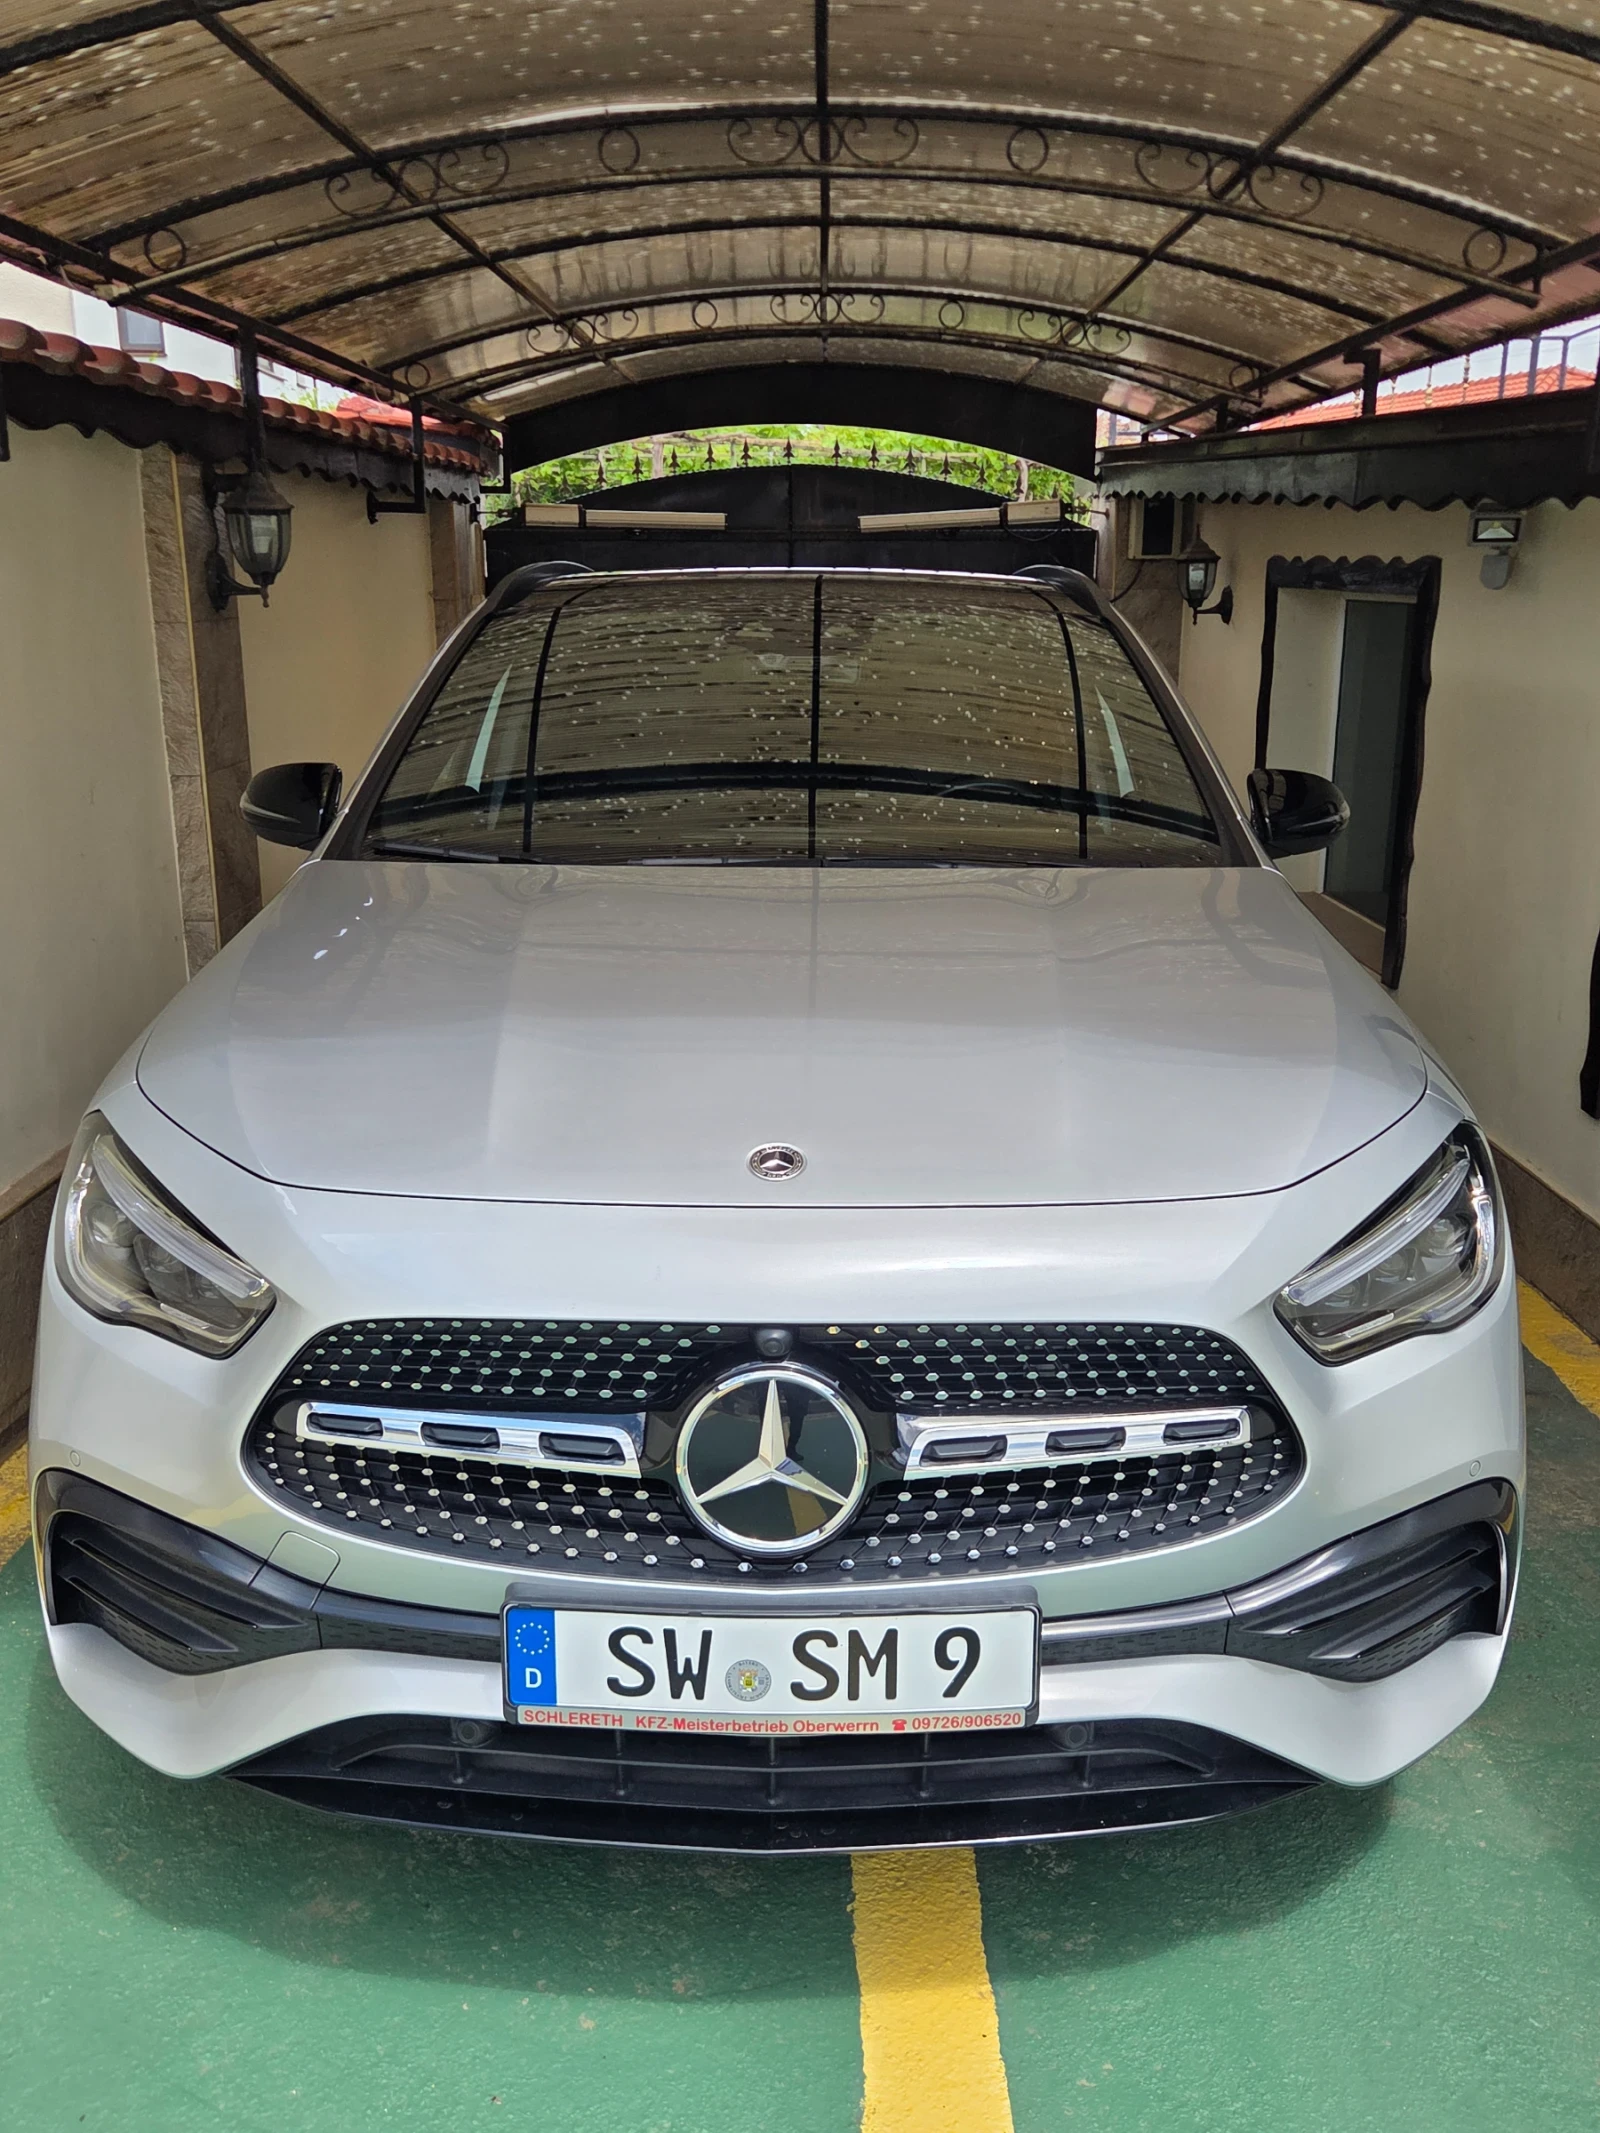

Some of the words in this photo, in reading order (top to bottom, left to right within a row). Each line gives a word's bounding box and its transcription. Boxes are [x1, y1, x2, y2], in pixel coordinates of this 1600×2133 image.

[607, 1626, 713, 1700] SW
[790, 1628, 898, 1701] SM
[934, 1626, 981, 1698] 9
[525, 1667, 542, 1688] D
[524, 1709, 623, 1727] SCHLERETH
[635, 1715, 789, 1733] KFZ-Meisterbetrieb
[793, 1719, 880, 1733] Oberwerrn
[912, 1712, 1022, 1730] 09726/906520
